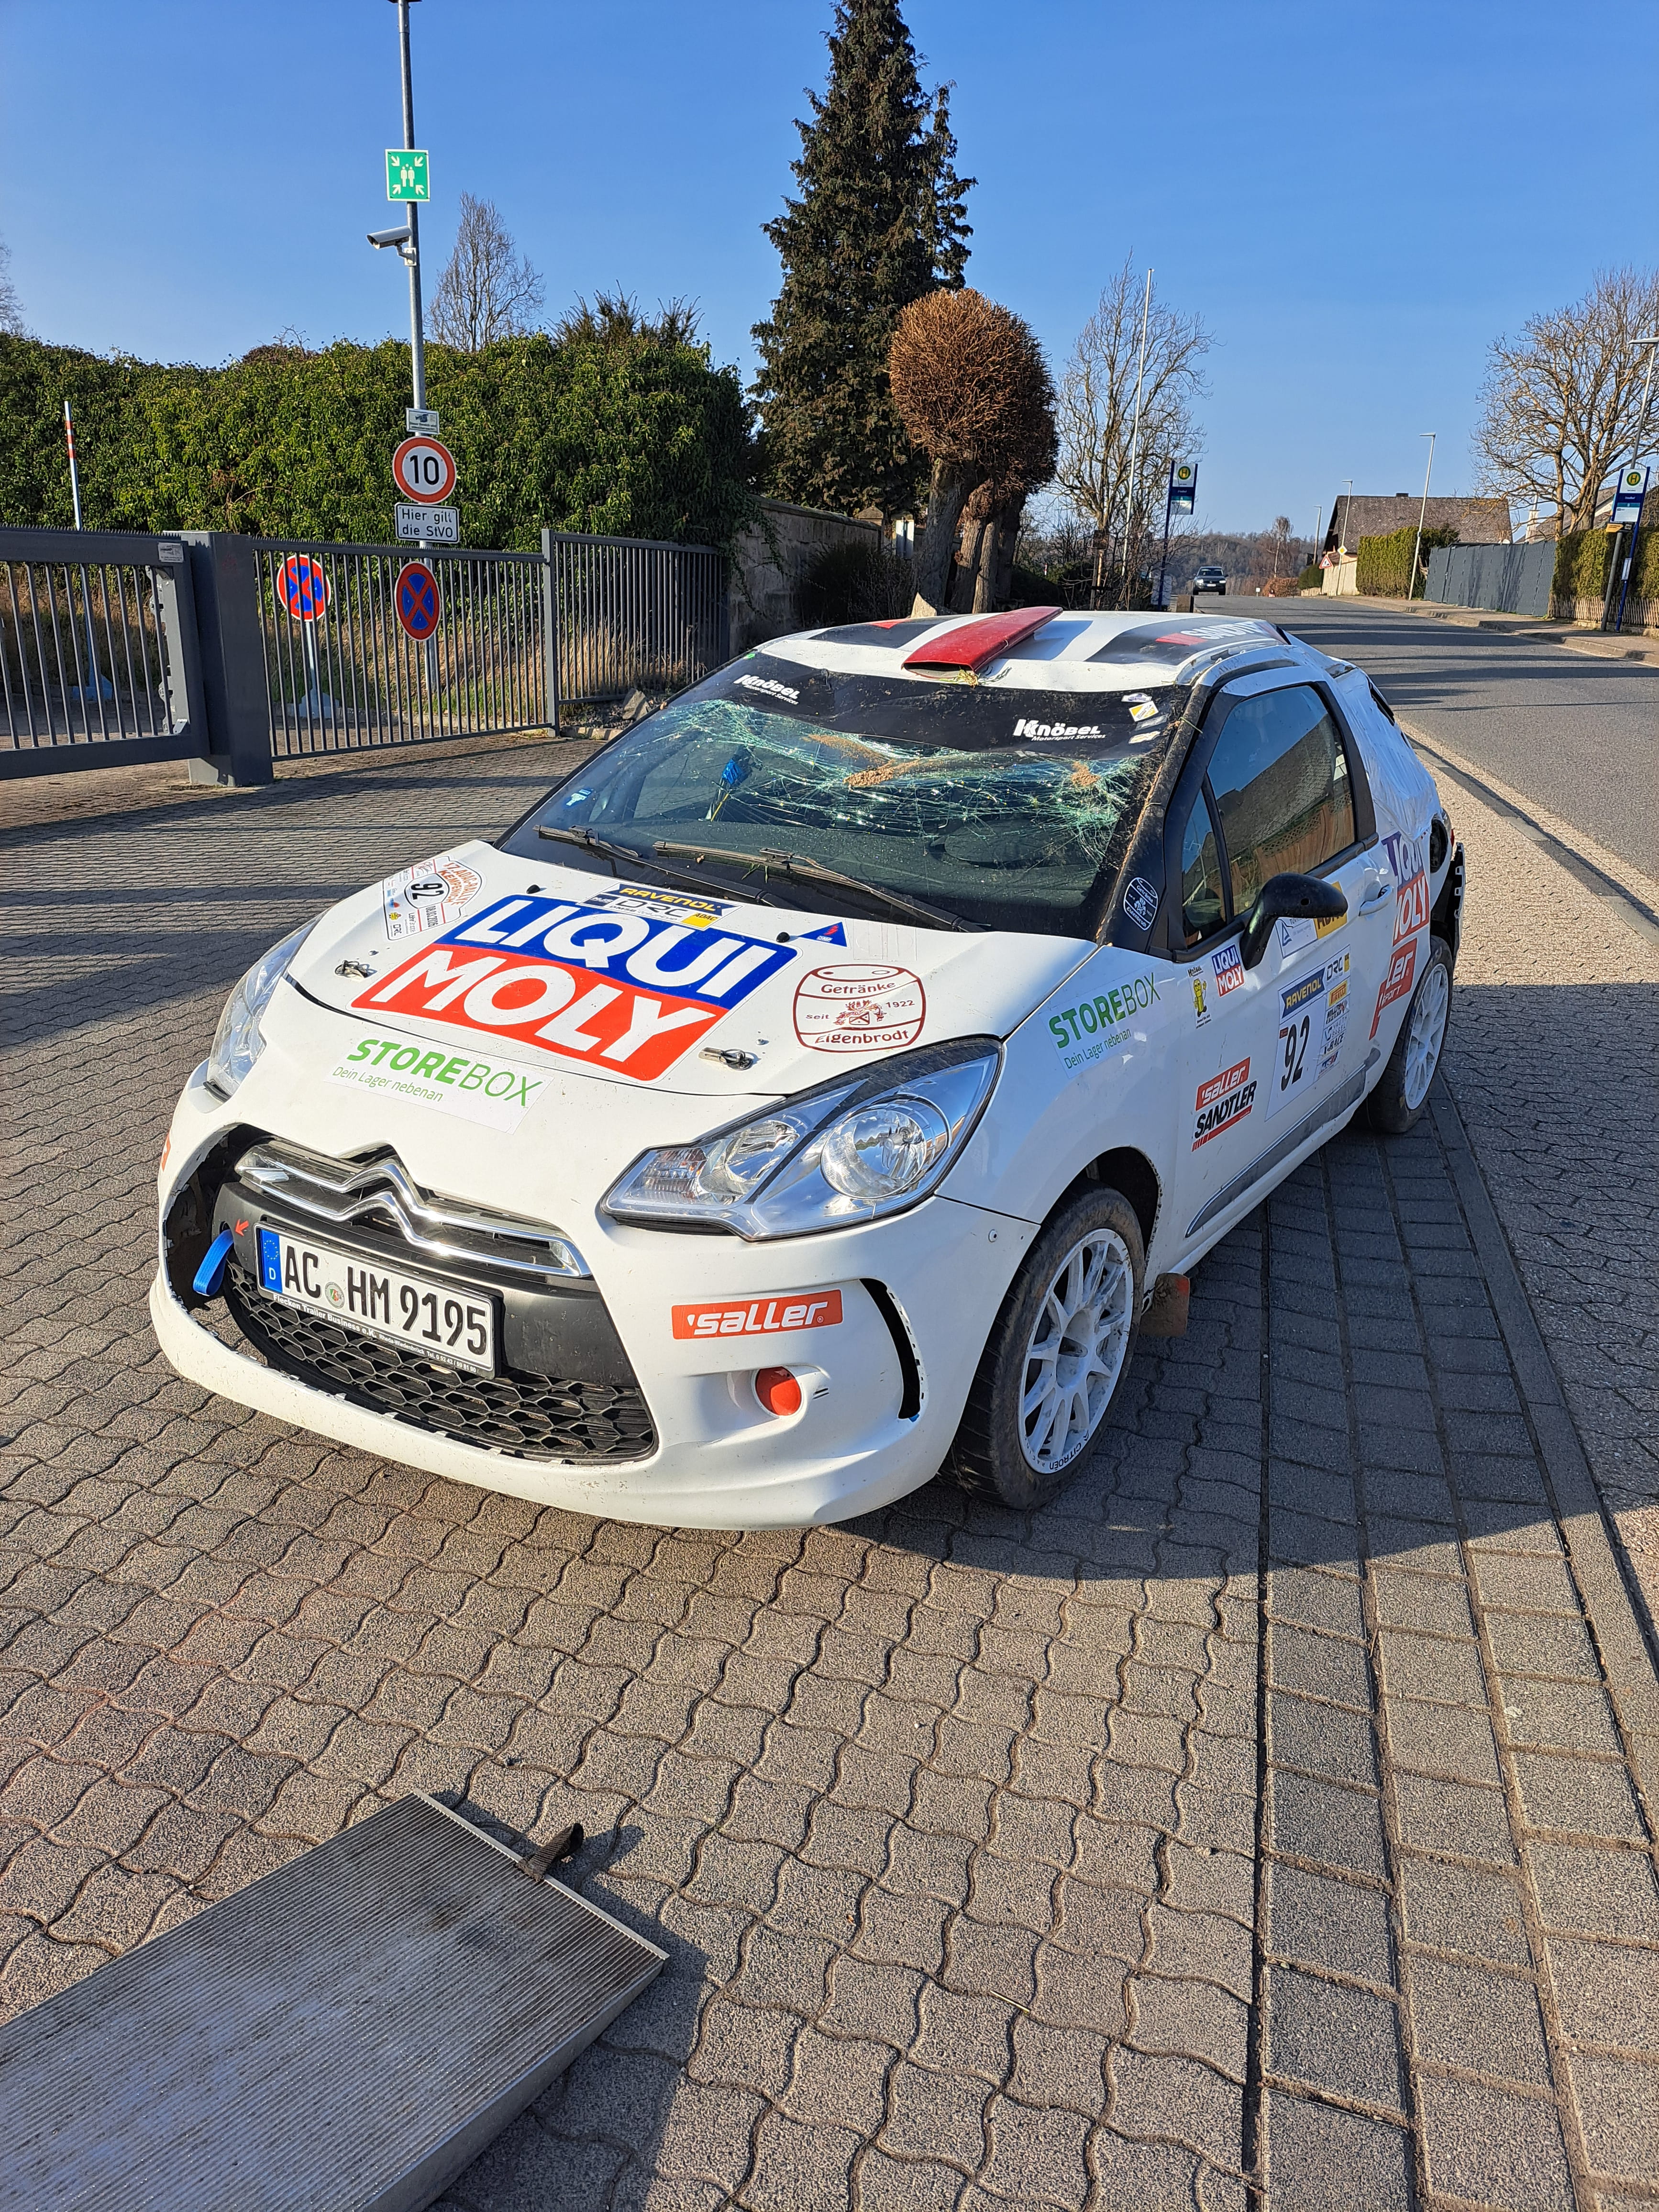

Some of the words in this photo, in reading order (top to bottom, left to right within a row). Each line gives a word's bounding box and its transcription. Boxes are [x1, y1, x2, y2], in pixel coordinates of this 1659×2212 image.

[410, 455, 439, 485] 10
[402, 509, 427, 520] Hier
[403, 524, 420, 535] die
[427, 526, 453, 537] StVO
[775, 694, 799, 705] Services
[410, 883, 444, 900] 92
[437, 870, 462, 904] KEMPENICH
[619, 887, 719, 911] RAVENOL
[616, 899, 688, 918] DRC
[694, 912, 718, 921] ADAC
[454, 900, 777, 998] LIQUI
[1213, 947, 1239, 974] LIQUI
[821, 982, 896, 994] Getränke
[1218, 966, 1242, 995] MOLY
[1286, 979, 1322, 1009] RAVENOL
[1327, 957, 1343, 981] DRC
[1331, 983, 1346, 1004] PIRELLI
[369, 950, 717, 1062] MOLY
[885, 1000, 915, 1008] 1922
[1049, 972, 1161, 1049] STOREBOX
[815, 1030, 910, 1044] Eigenbrodt
[1064, 1052, 1084, 1069] Dein
[1083, 1043, 1103, 1060] Lager
[1104, 1029, 1131, 1049] nebenan
[1281, 1015, 1310, 1091] 92
[332, 1066, 357, 1081] Dein
[358, 1072, 392, 1088] Lager
[392, 1081, 442, 1102] nebenan
[347, 1039, 543, 1106] STOREBOX
[1195, 1081, 1257, 1139] SANDTLER
[269, 1267, 276, 1281] D
[285, 1246, 321, 1299] AC
[347, 1266, 390, 1324] HM
[400, 1285, 487, 1355] 9195
[273, 1294, 301, 1310] Flecken
[302, 1304, 326, 1318] Trailer
[328, 1313, 360, 1332] Business
[362, 1328, 377, 1338] e.K.
[379, 1334, 425, 1355] Rheda-Wiedenbrück
